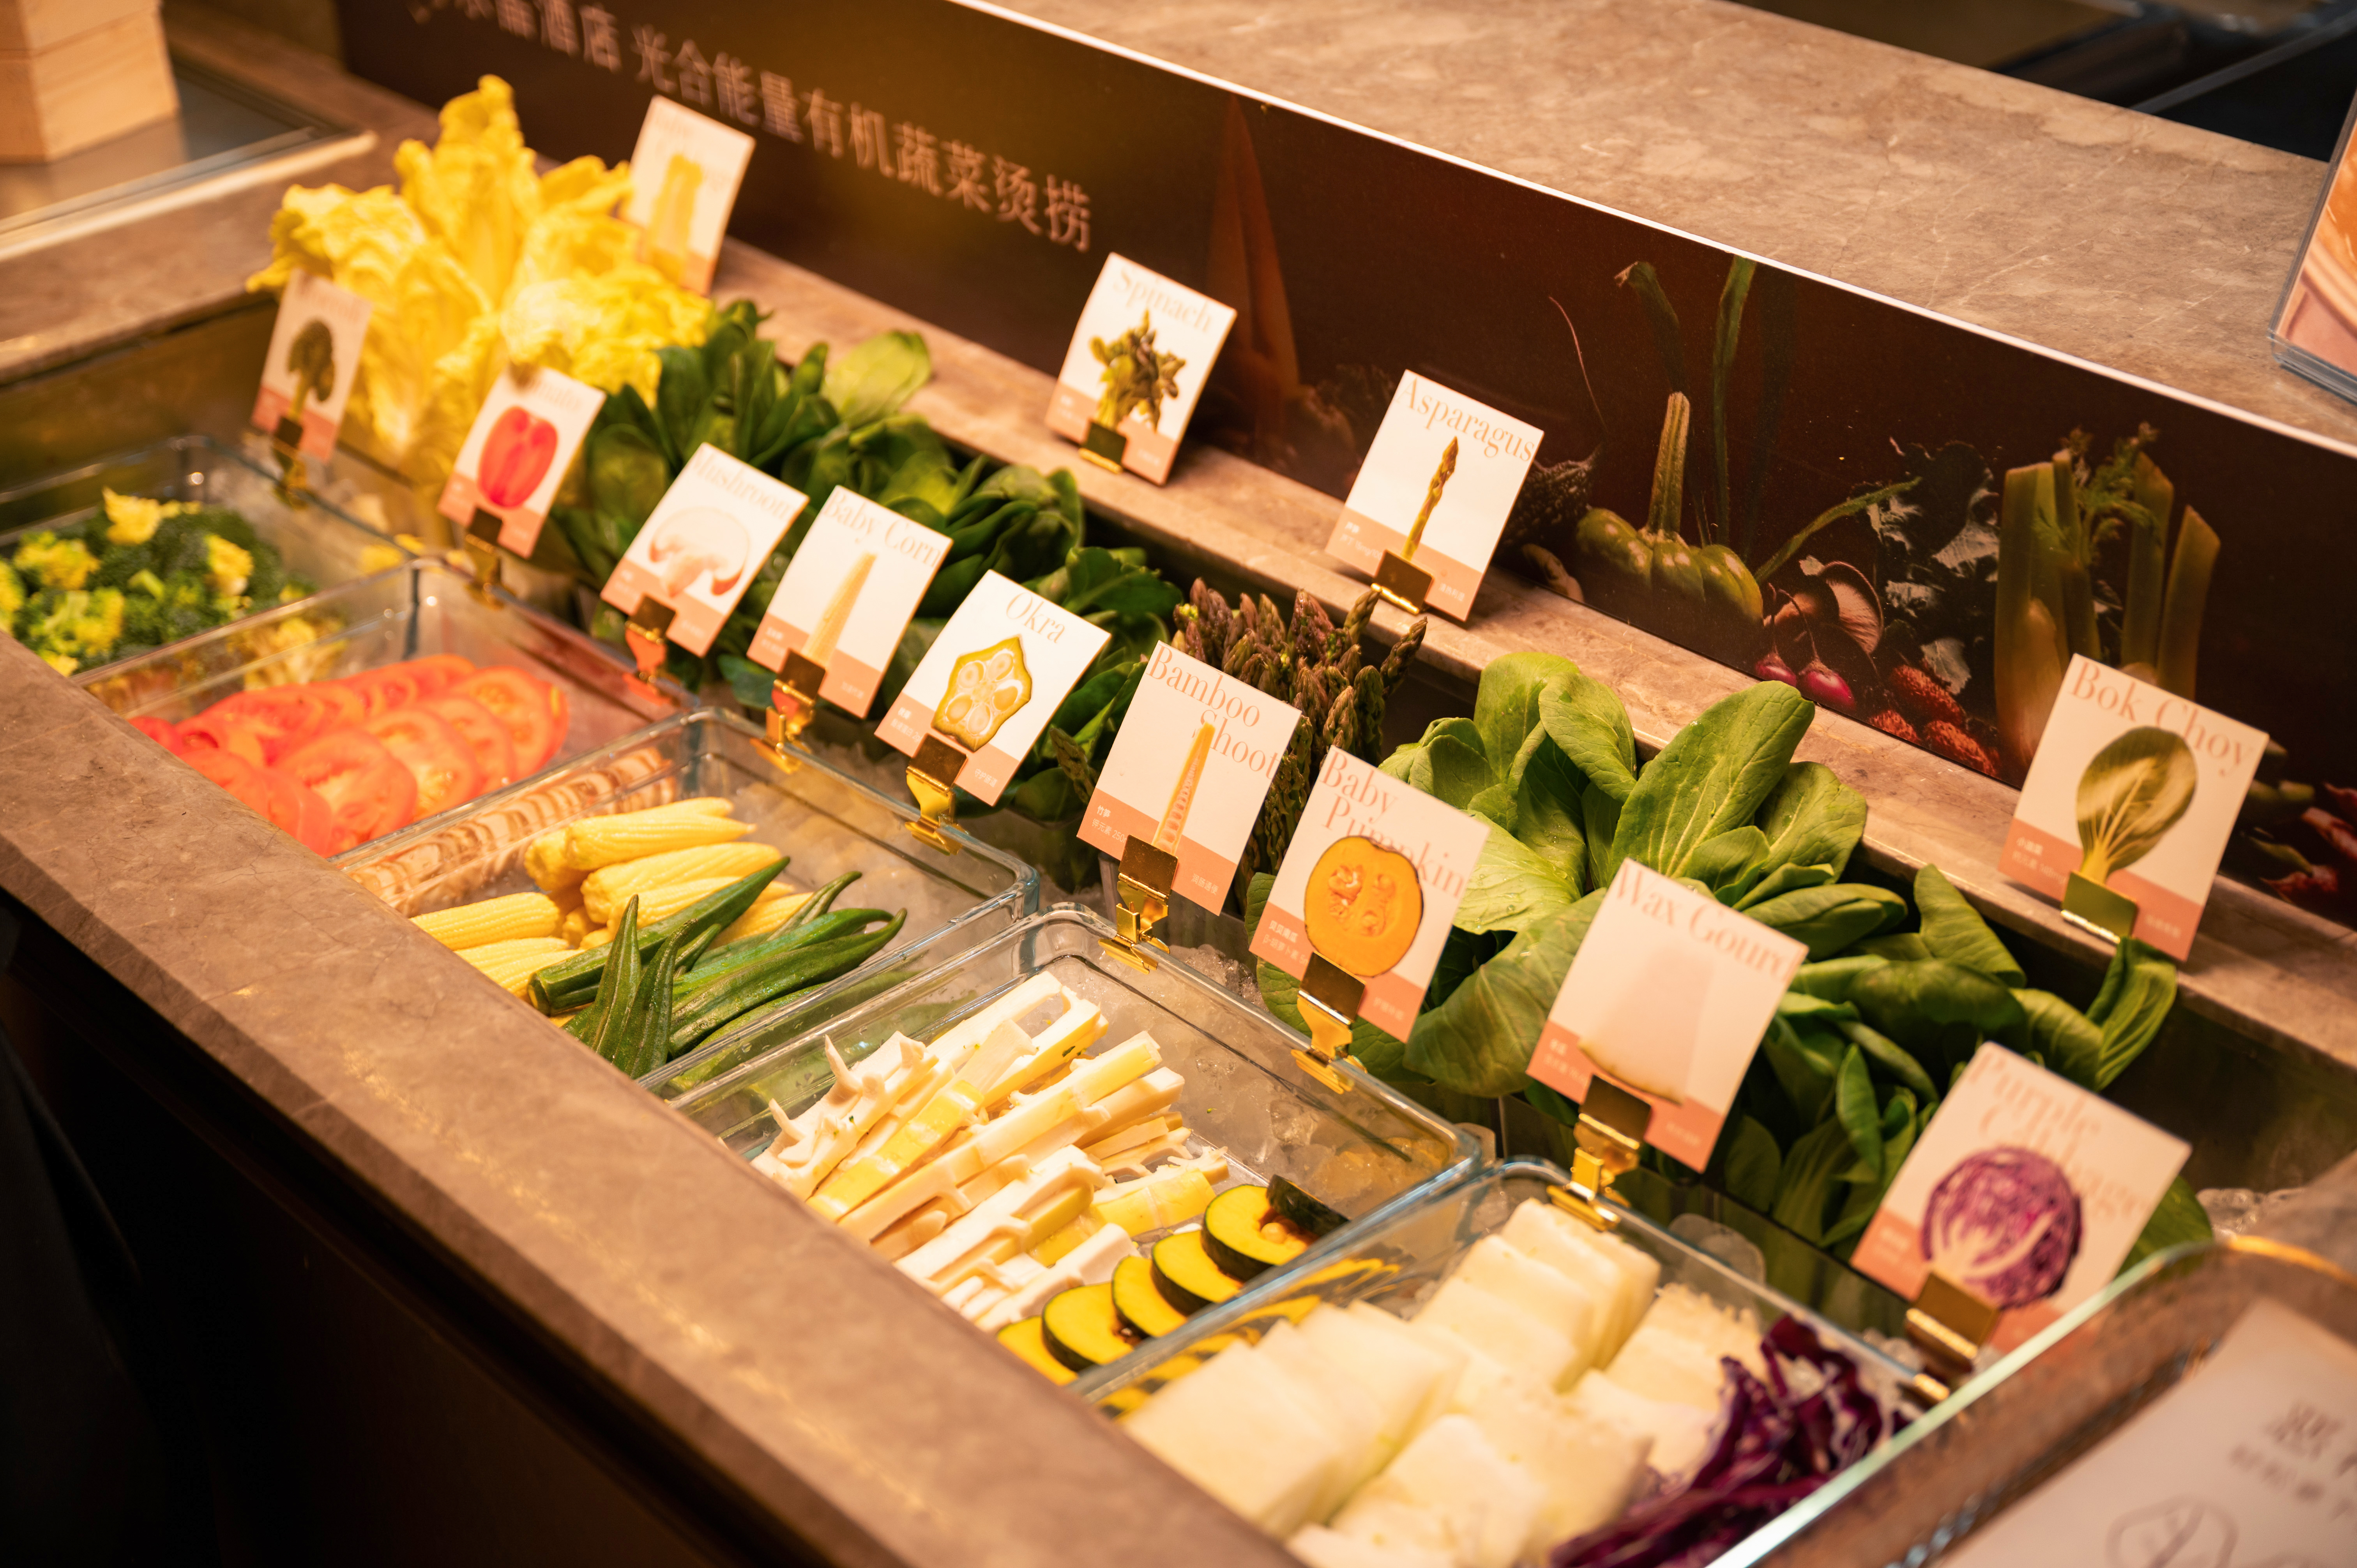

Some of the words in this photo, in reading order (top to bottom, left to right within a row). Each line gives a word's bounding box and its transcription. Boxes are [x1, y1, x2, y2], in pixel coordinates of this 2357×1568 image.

[631, 23, 1090, 253] 光合能量有机蔬菜烫捞
[1113, 267, 1212, 332] Spinach
[1395, 377, 1535, 462] Asparagus
[822, 489, 882, 543] Baby
[884, 517, 942, 568] Corn
[1005, 592, 1066, 644] Okra
[1145, 643, 1260, 727] Bamboo
[2069, 661, 2137, 722] Bok
[2154, 698, 2254, 776] Choy
[975, 768, 998, 788] 守护肠道
[1319, 750, 1399, 824] Baby
[1092, 818, 1112, 836] 钾元素
[1097, 805, 1111, 817] 竹笋
[1191, 873, 1219, 895] 润肠通便
[1615, 860, 1683, 927] Wax
[1263, 934, 1299, 960] β-胡萝卜素
[1269, 920, 1298, 943] 贝贝南瓜
